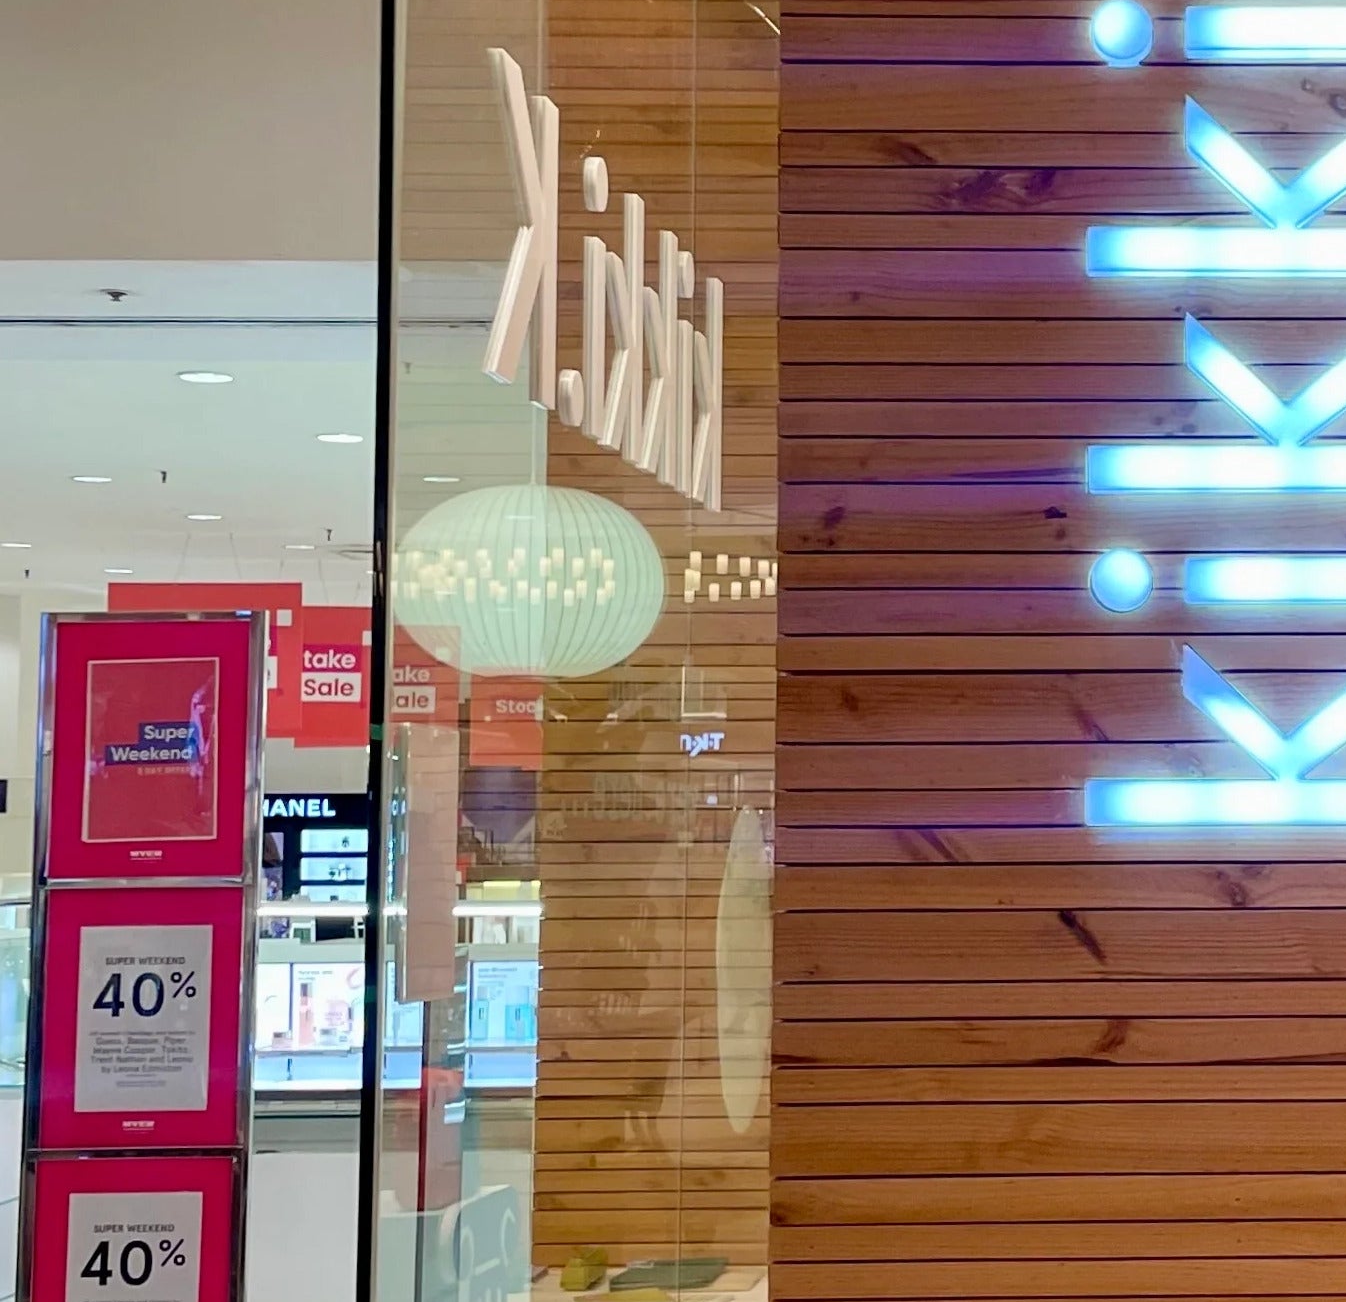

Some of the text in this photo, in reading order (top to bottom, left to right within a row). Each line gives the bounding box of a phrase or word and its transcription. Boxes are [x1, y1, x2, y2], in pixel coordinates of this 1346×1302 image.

[304, 650, 356, 669] take
[393, 666, 430, 682] ake
[304, 679, 354, 697] Sale
[396, 691, 429, 709] ale
[144, 725, 196, 742] Super
[111, 746, 193, 762] Weekend
[106, 956, 186, 965] SUPER WEEKEND
[93, 970, 196, 1017] 40%
[94, 1224, 175, 1233] SUPER WEEKEND
[80, 1238, 186, 1286] 40%
